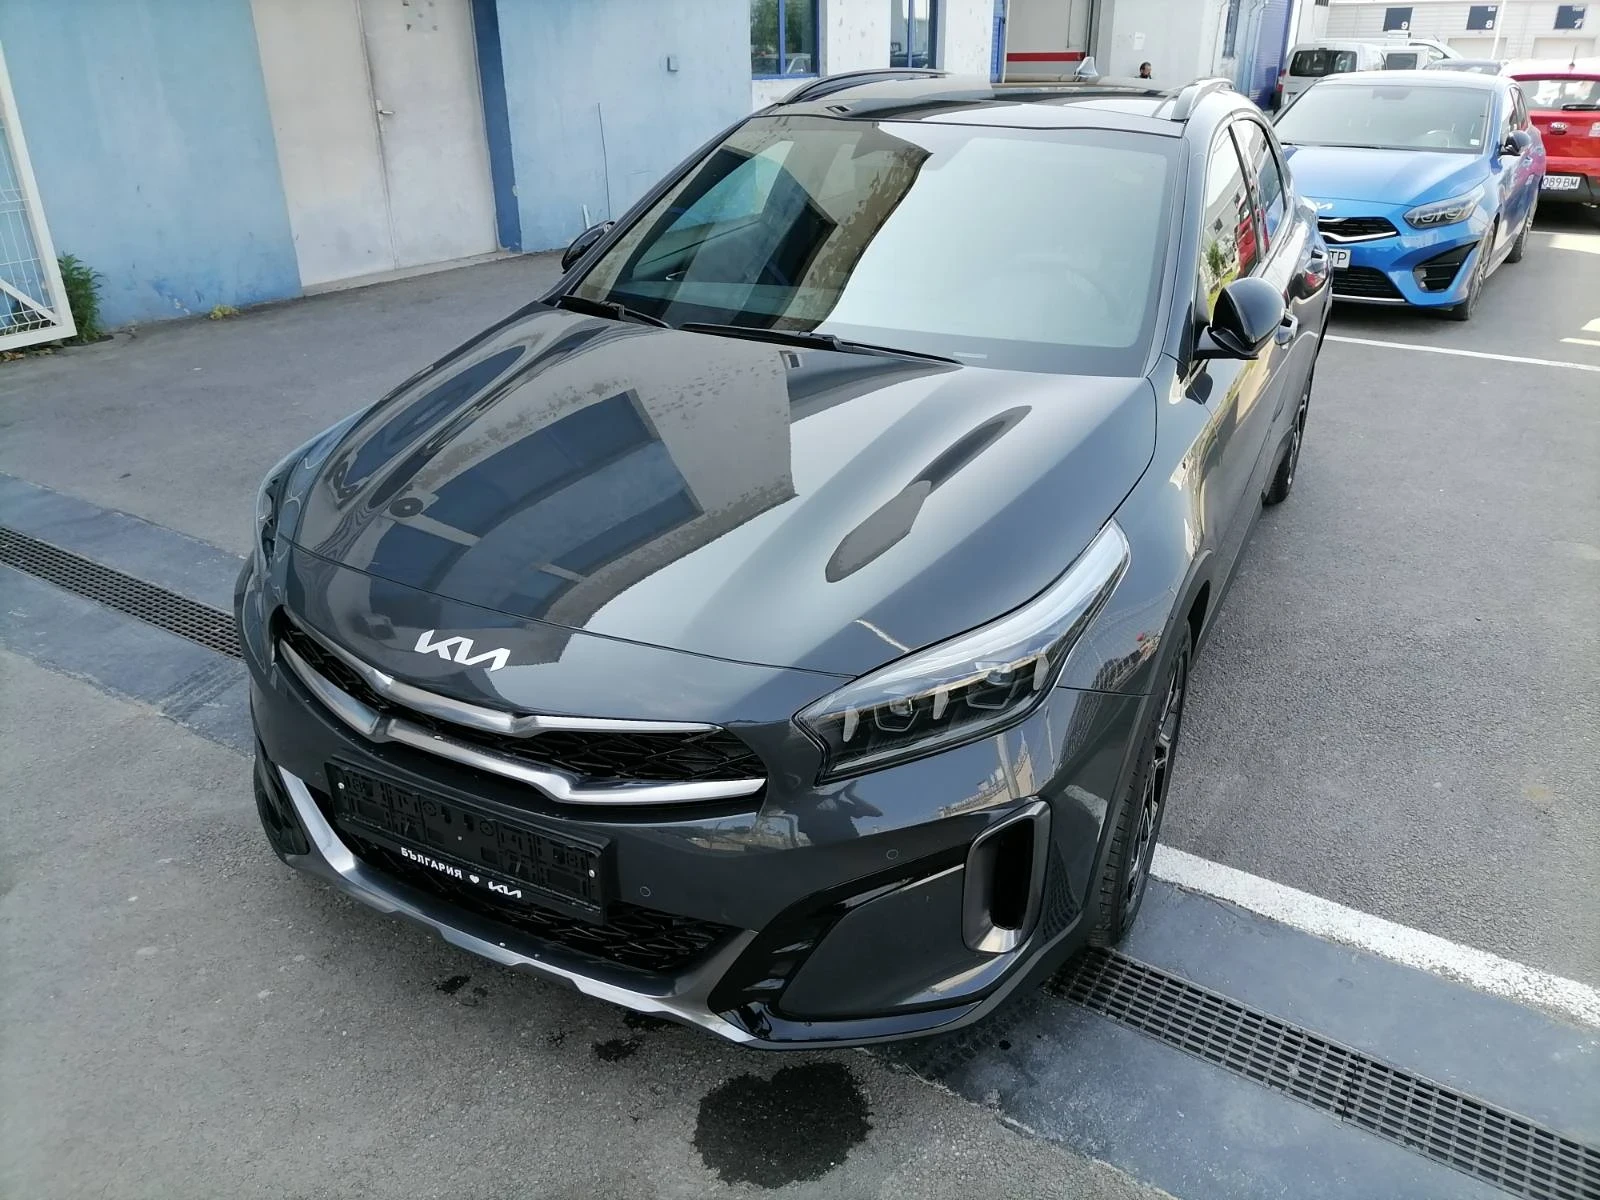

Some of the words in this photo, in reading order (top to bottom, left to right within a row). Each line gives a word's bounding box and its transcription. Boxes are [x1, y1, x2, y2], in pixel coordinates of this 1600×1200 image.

[1401, 21, 1408, 30] 9
[1485, 20, 1493, 29] 8
[414, 629, 511, 672] KIA
[400, 846, 463, 880] БЪЛГАРИЯ
[488, 880, 522, 899] KIA
